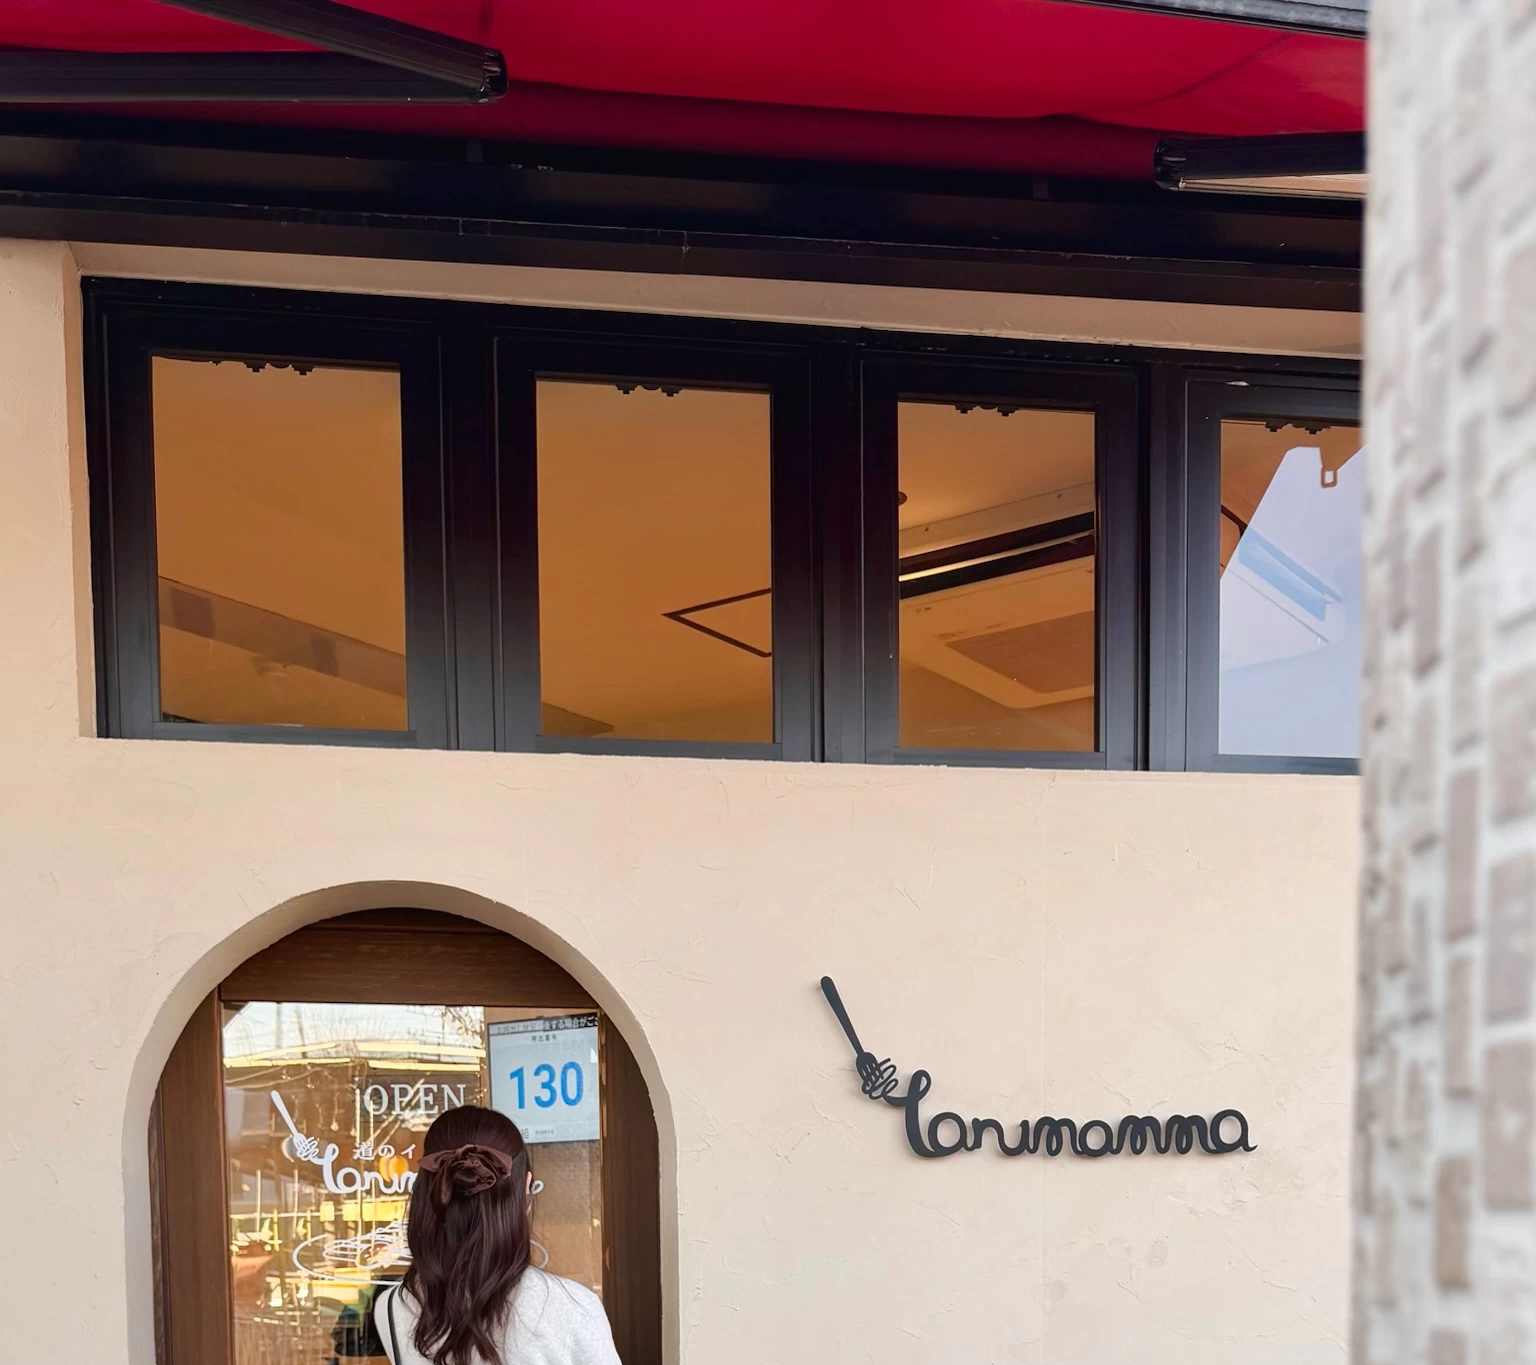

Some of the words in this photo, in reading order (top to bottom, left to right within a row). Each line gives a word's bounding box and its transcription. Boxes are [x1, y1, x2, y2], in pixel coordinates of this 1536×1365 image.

[363, 1084, 466, 1115] OPEN
[509, 1061, 583, 1109] 130
[352, 1143, 417, 1160] 道のイ
